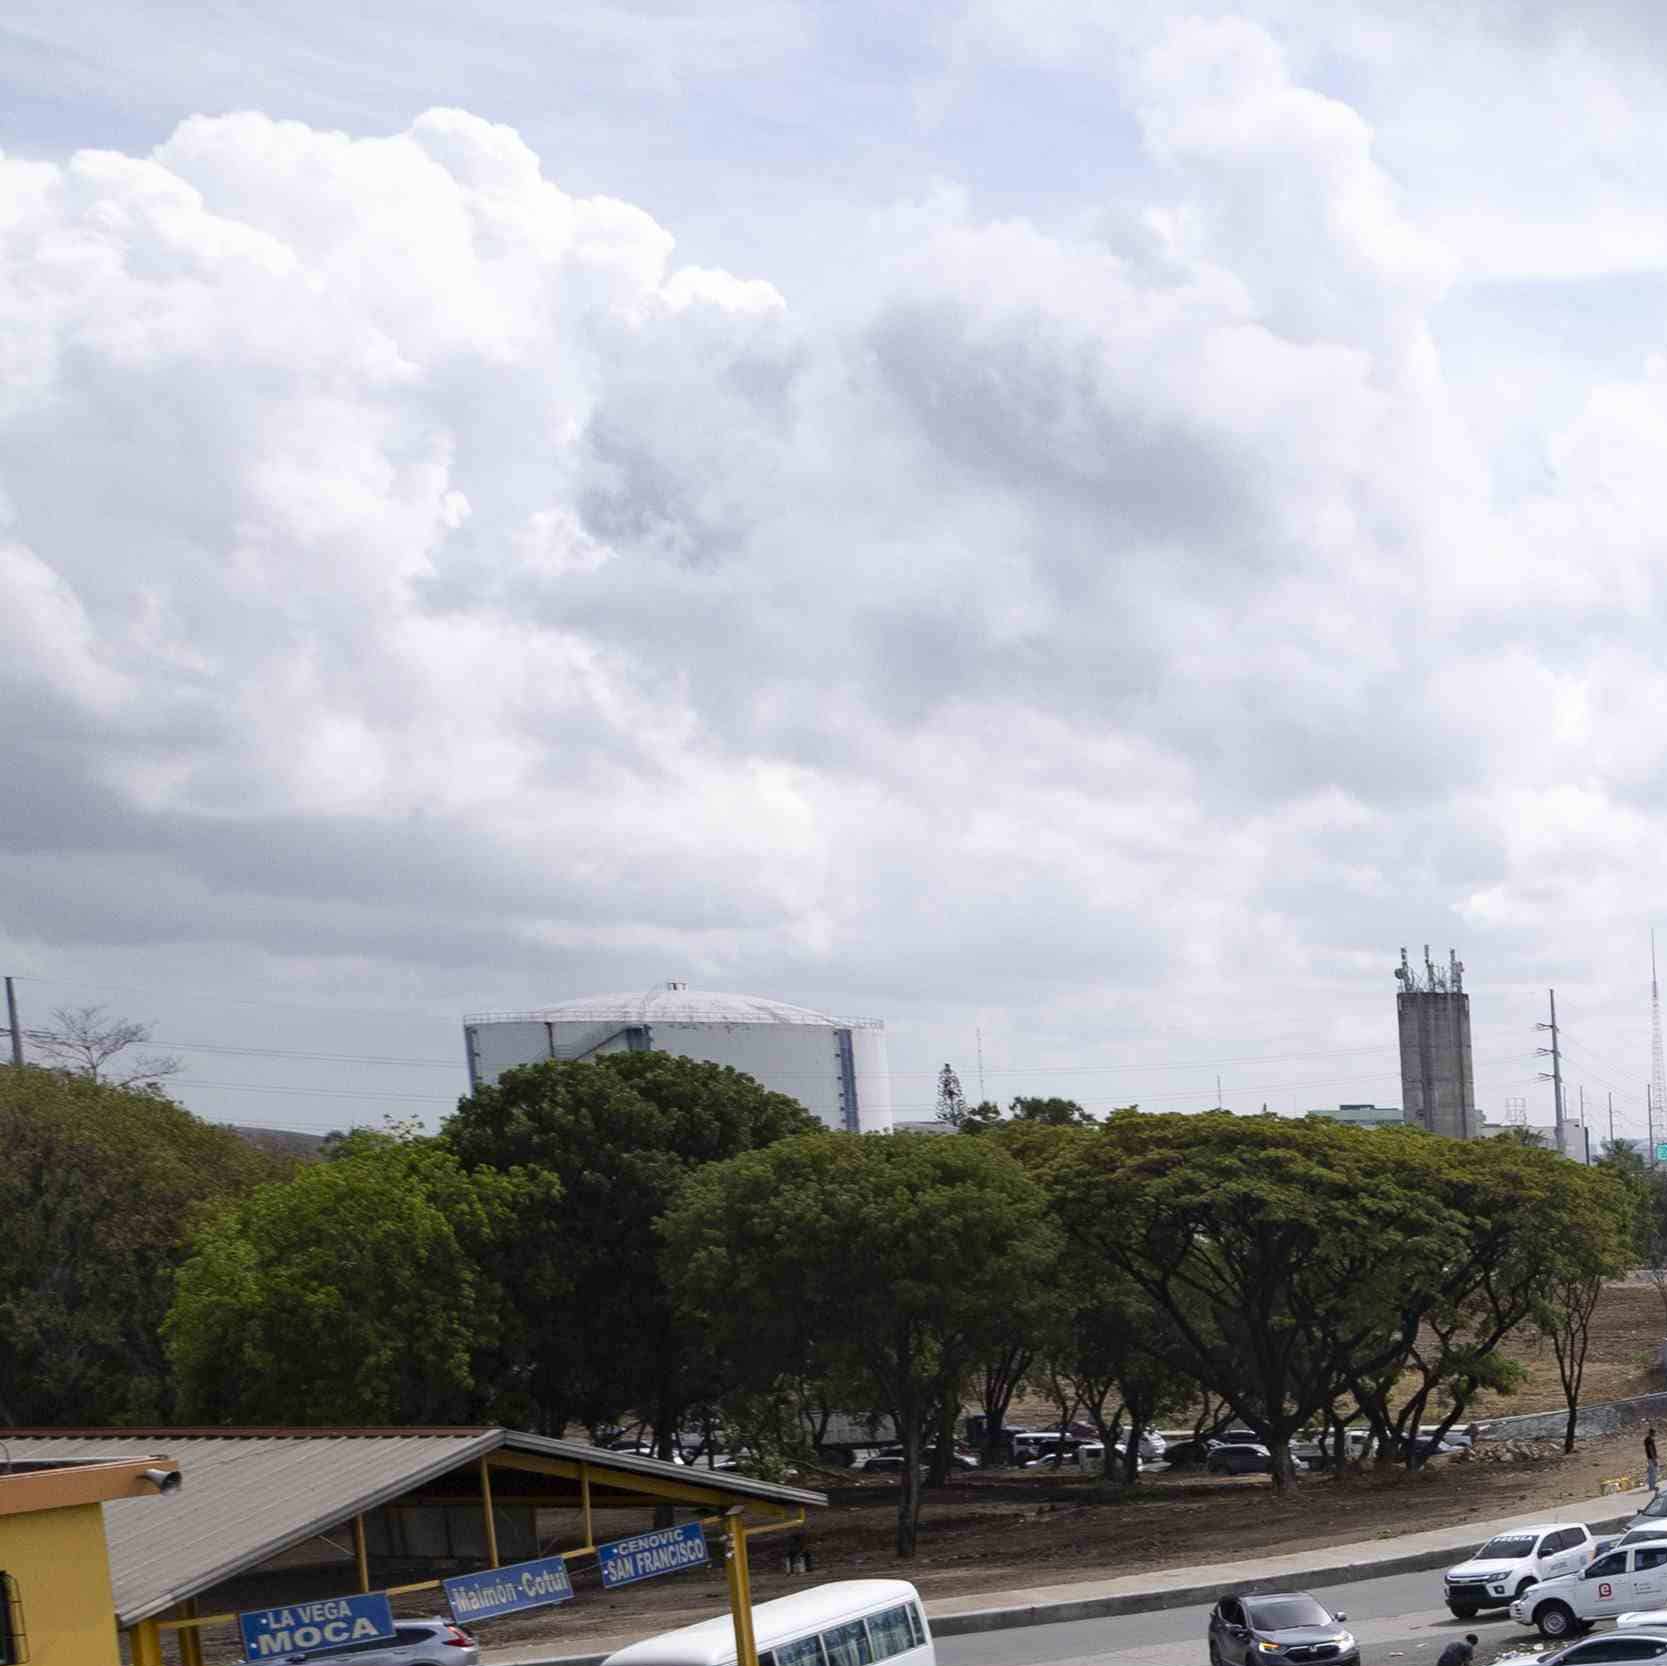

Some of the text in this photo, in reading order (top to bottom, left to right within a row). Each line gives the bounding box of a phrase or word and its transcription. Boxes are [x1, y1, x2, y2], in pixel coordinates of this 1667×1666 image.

[618, 1529, 685, 1556] CENOVIC
[607, 1539, 705, 1582] SAN FRANCISCO
[268, 1601, 352, 1629] LA VEGA
[257, 1617, 379, 1655] MOCA
